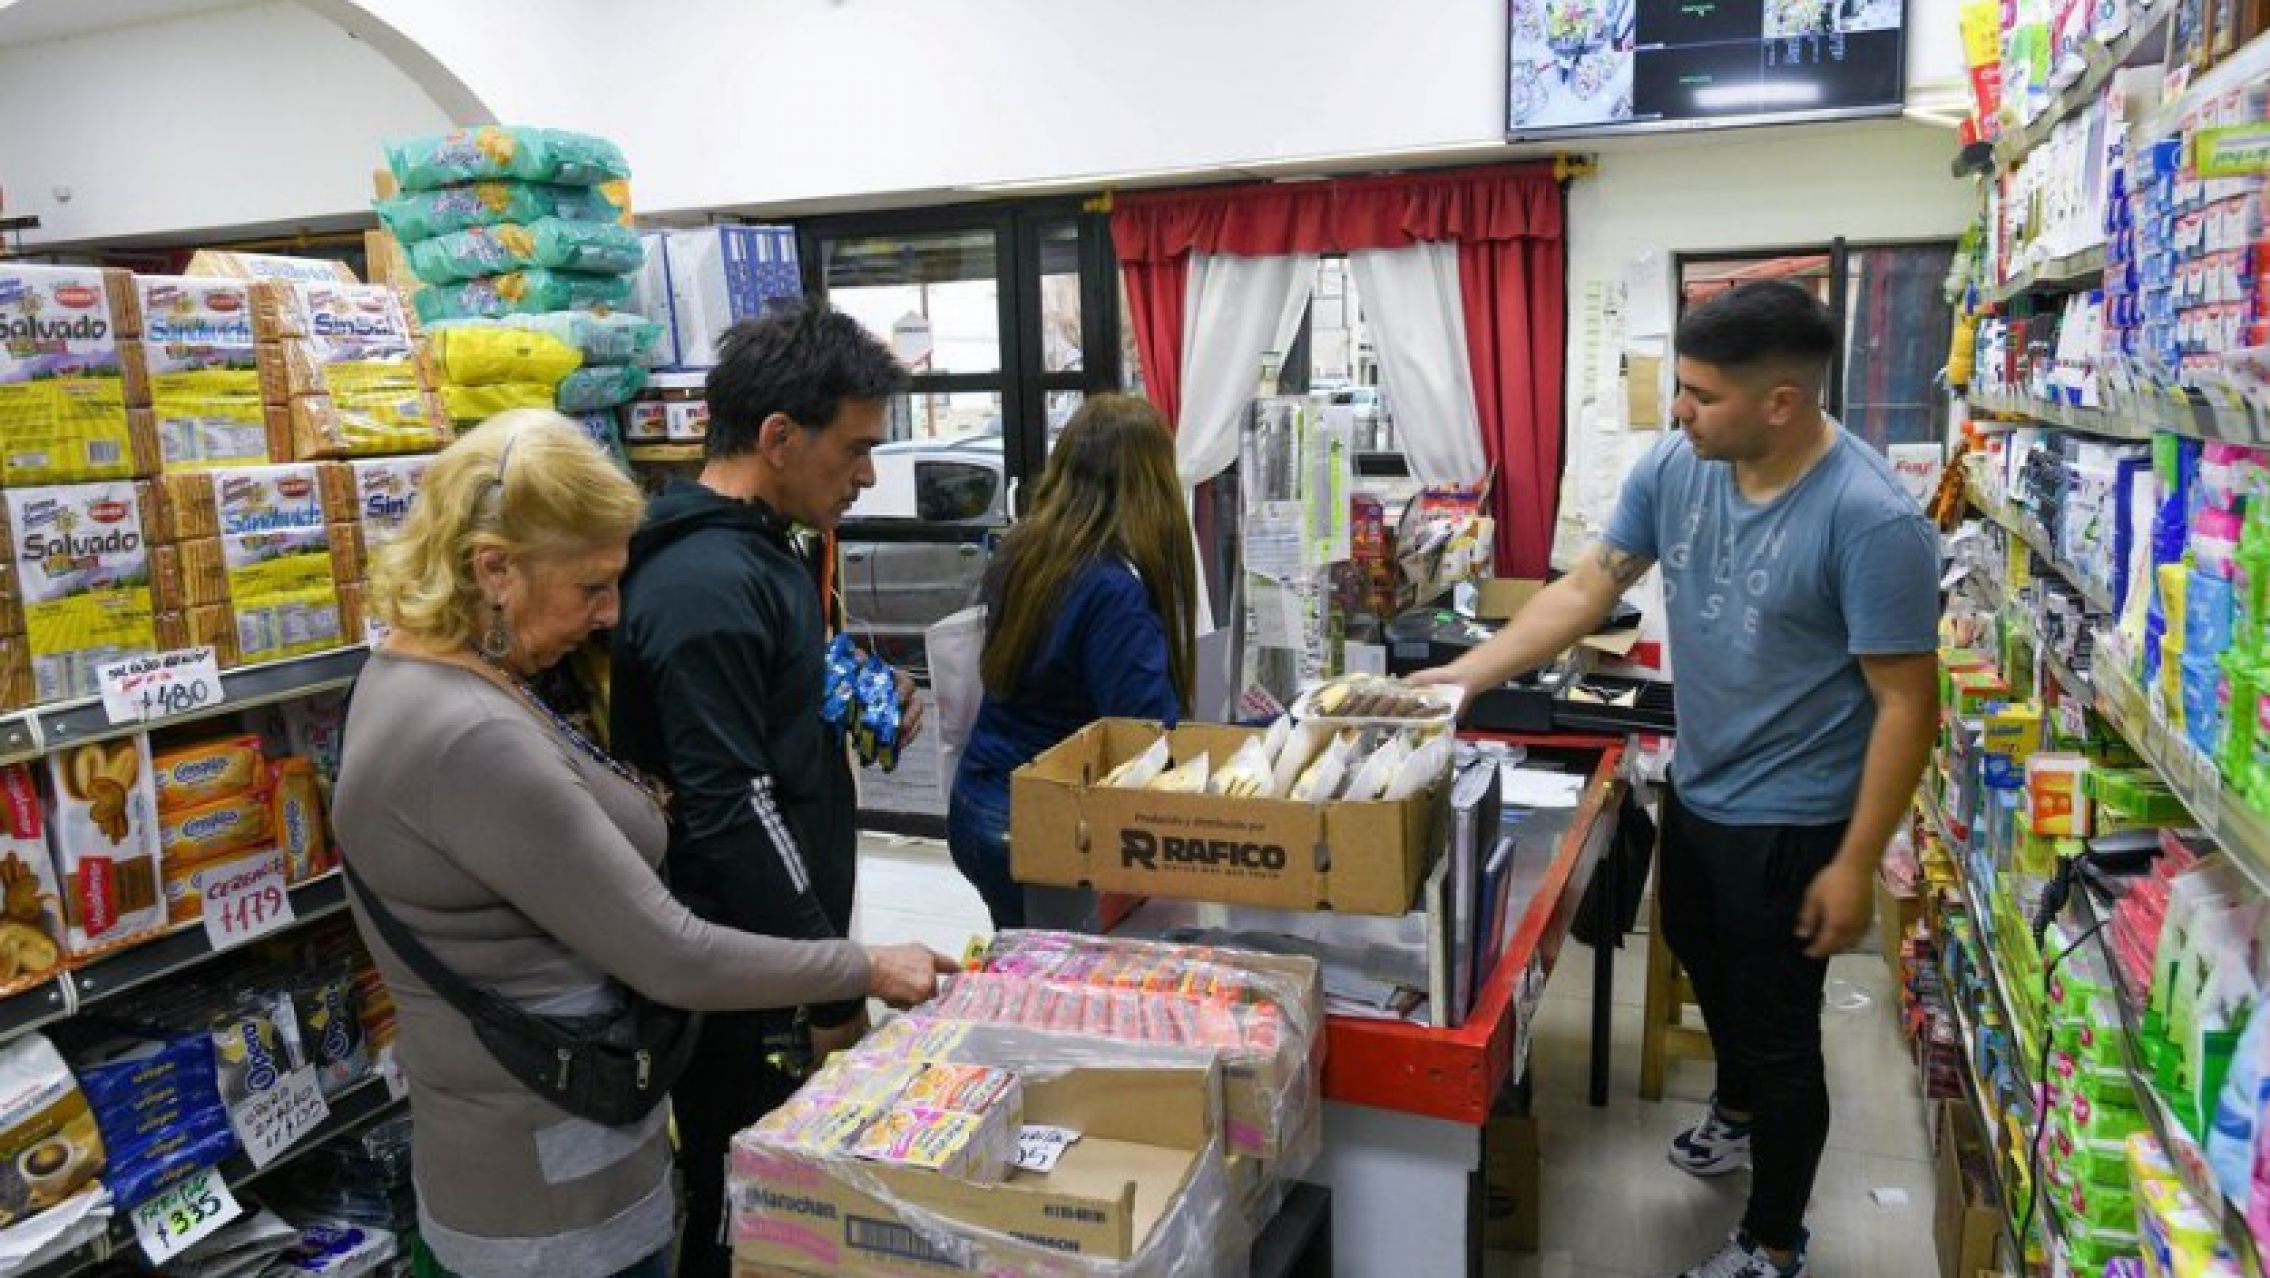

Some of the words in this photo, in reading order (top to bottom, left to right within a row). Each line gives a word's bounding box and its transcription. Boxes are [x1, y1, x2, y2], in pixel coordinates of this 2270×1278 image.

[0, 314, 107, 341] Salvado
[21, 528, 140, 561] Salvado
[1163, 836, 1286, 870] RAFICO
